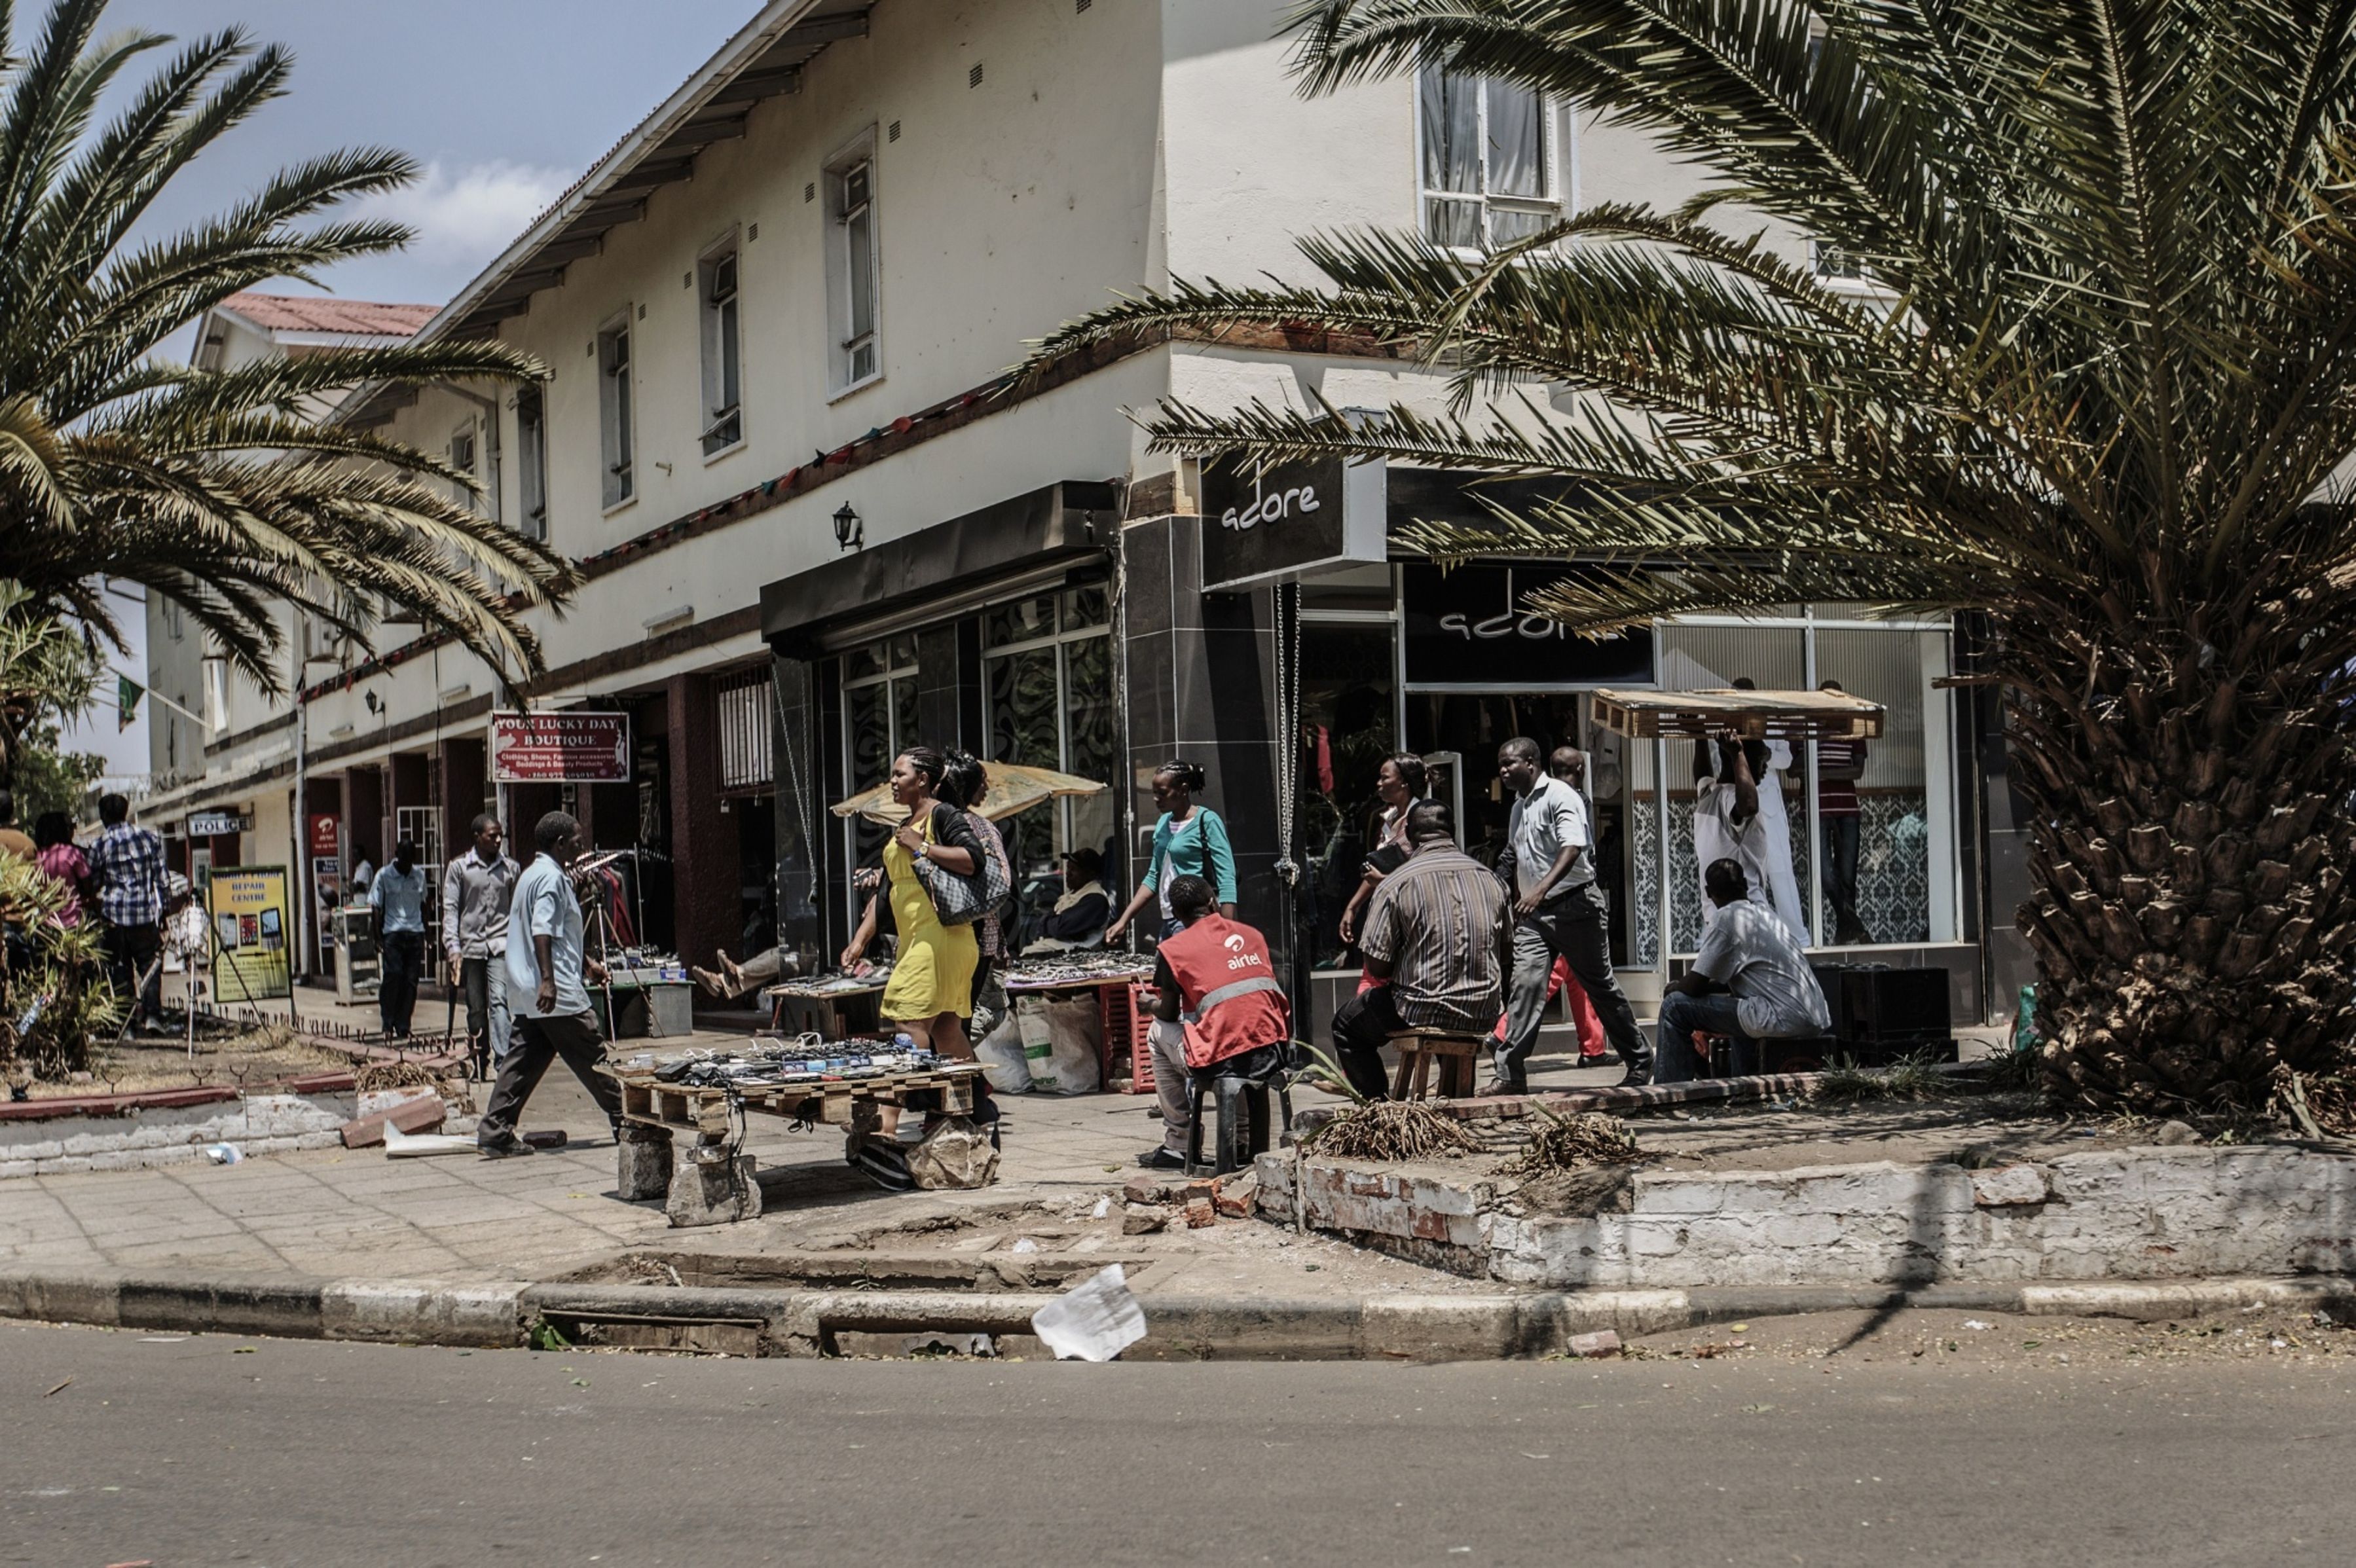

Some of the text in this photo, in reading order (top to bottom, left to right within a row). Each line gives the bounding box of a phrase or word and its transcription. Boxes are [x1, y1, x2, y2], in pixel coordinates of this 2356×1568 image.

[1221, 460, 1320, 531] adore
[1440, 568, 1619, 640] ado
[539, 719, 586, 730] LUCKY
[589, 719, 617, 729] DAY
[524, 735, 597, 746] BOUTIQUE
[195, 818, 248, 832] POLICE
[232, 894, 265, 902] CENTRE
[1227, 953, 1262, 970] airtel
